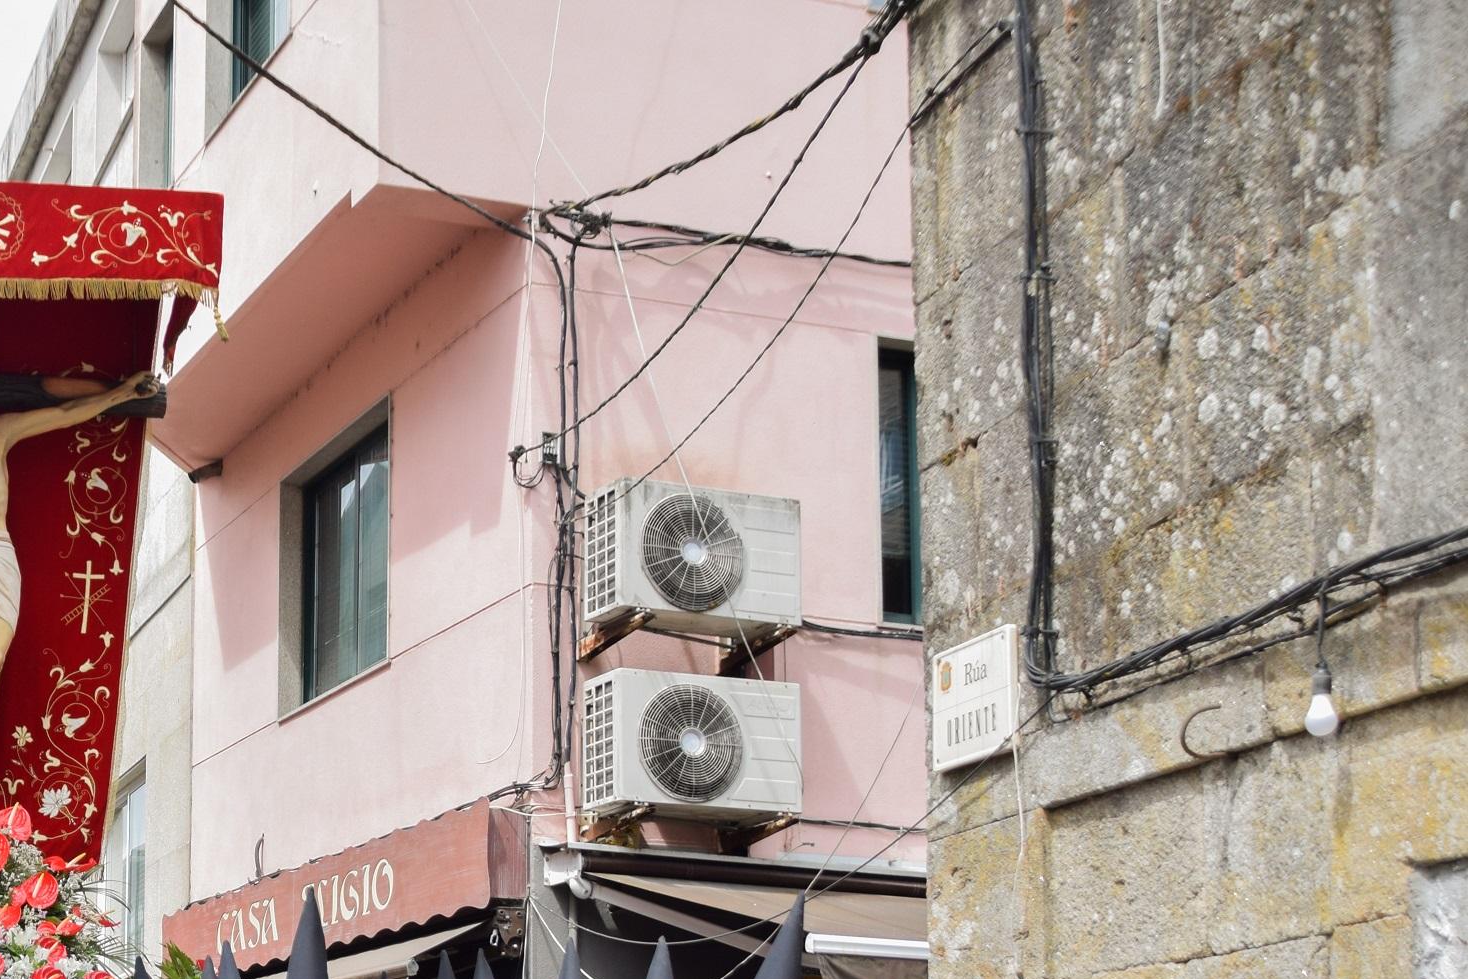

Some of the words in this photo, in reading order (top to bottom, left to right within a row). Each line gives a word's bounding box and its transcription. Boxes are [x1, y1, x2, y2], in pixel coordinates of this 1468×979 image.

[963, 660, 987, 687] Rúa
[947, 703, 996, 747] ORIENTE
[216, 897, 279, 955] CASA
[302, 859, 394, 928] LIGIO
